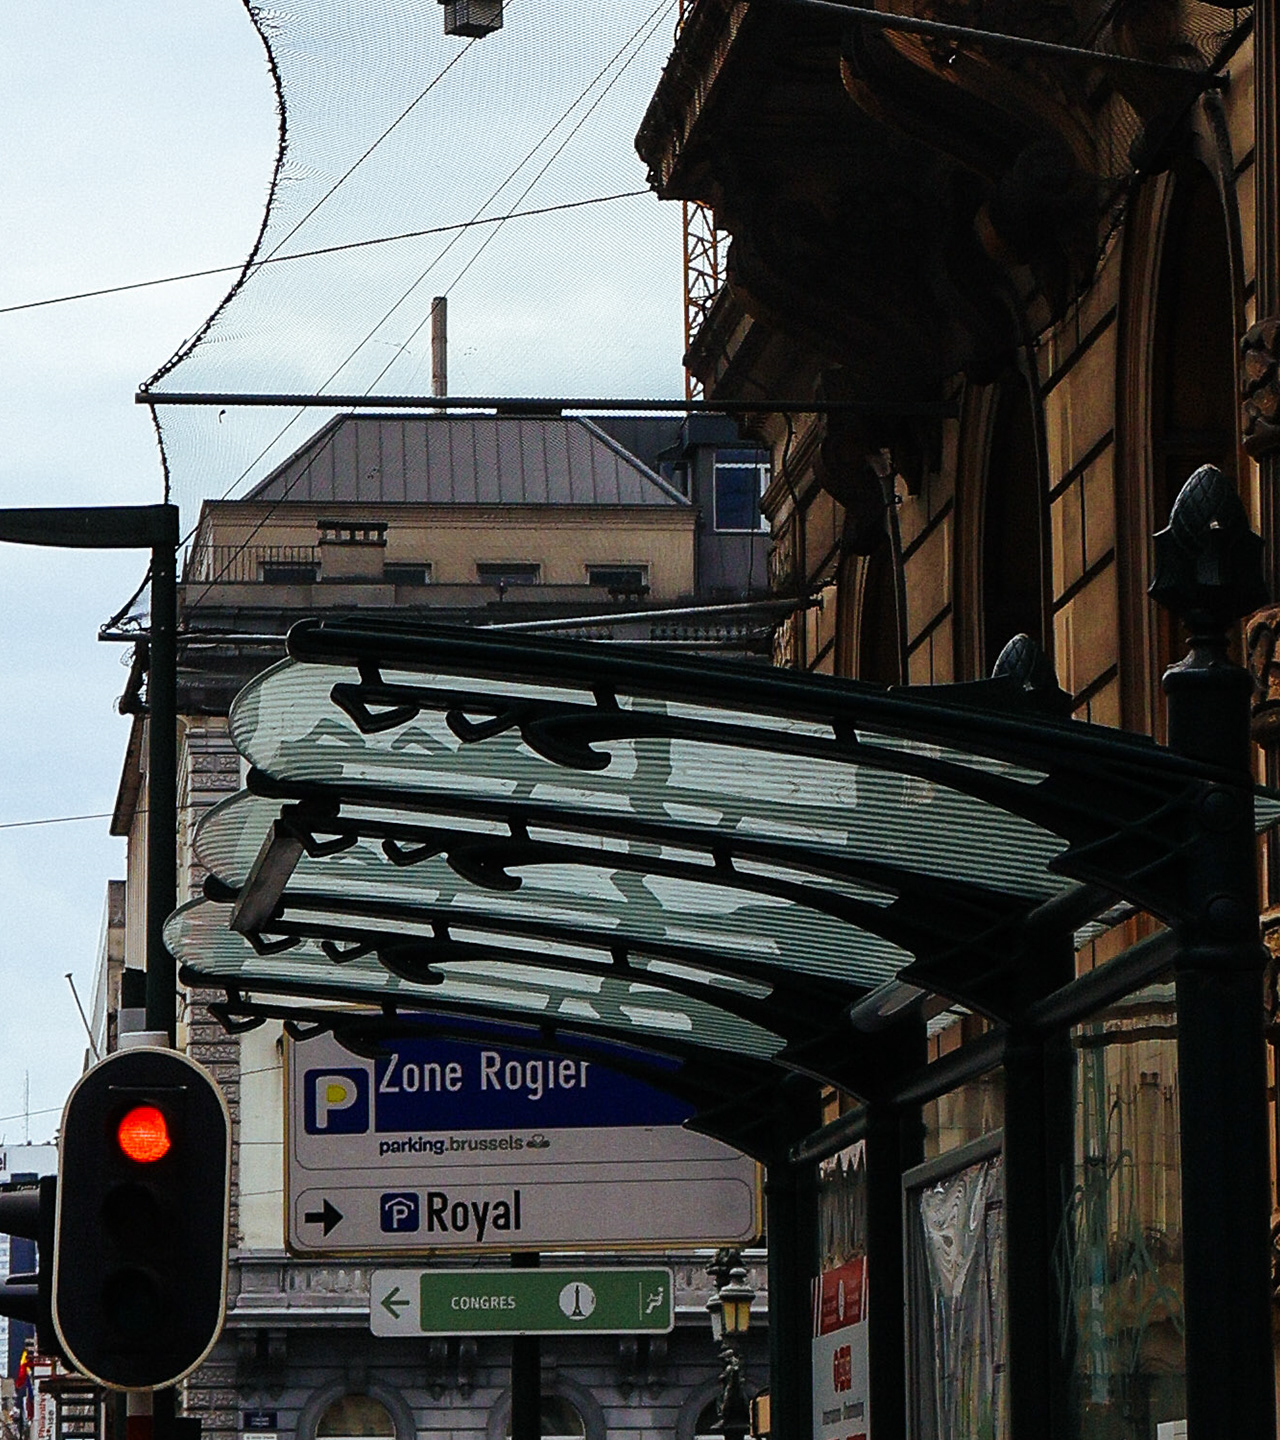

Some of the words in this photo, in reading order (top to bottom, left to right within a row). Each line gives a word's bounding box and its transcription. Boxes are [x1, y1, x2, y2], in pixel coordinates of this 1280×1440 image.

[379, 1052, 464, 1094] Zone
[479, 1050, 592, 1102] Rogier
[379, 1135, 524, 1157] parking.brussels
[426, 1189, 522, 1242] Royal
[450, 1296, 517, 1311] CONGRES
